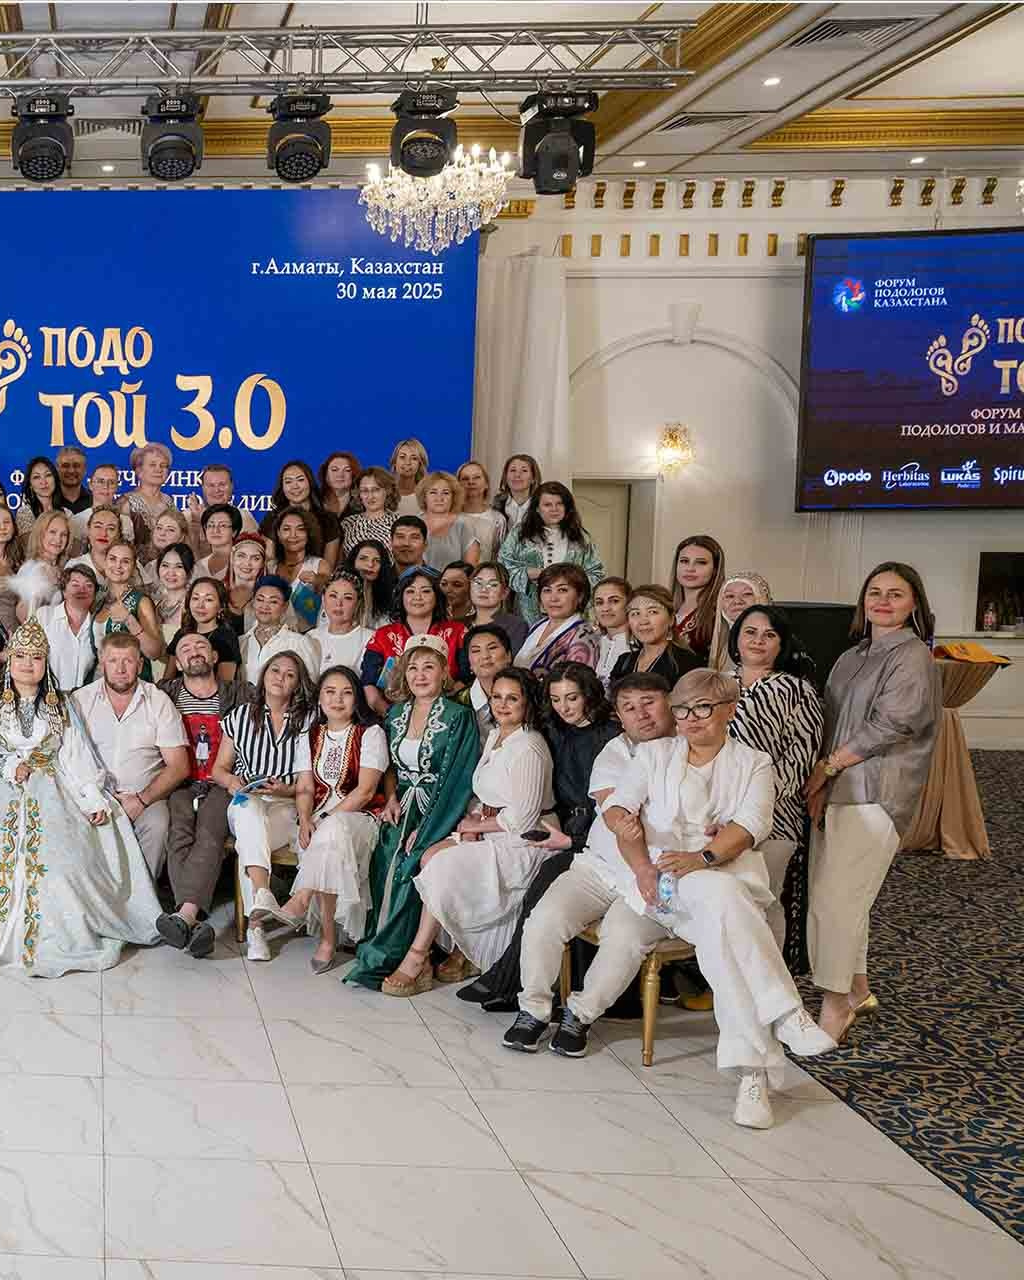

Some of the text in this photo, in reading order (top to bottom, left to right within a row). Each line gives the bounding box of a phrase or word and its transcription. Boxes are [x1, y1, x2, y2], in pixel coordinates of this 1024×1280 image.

[350, 258, 443, 274] Казахстан
[874, 278, 916, 288] ФОРУМ
[337, 283, 442, 299] 30 мая 2025
[874, 287, 944, 298] ПОДОЛОГОВ
[873, 297, 948, 308] КАЗАХСТАНА
[40, 327, 152, 375] ПОДО
[38, 374, 286, 451] ТОЙ 3.0
[971, 408, 1021, 420] ФОРУМ
[901, 423, 986, 438] ПОДОЛОГОВ
[989, 423, 1001, 435] И
[882, 471, 930, 482] Herbitas
